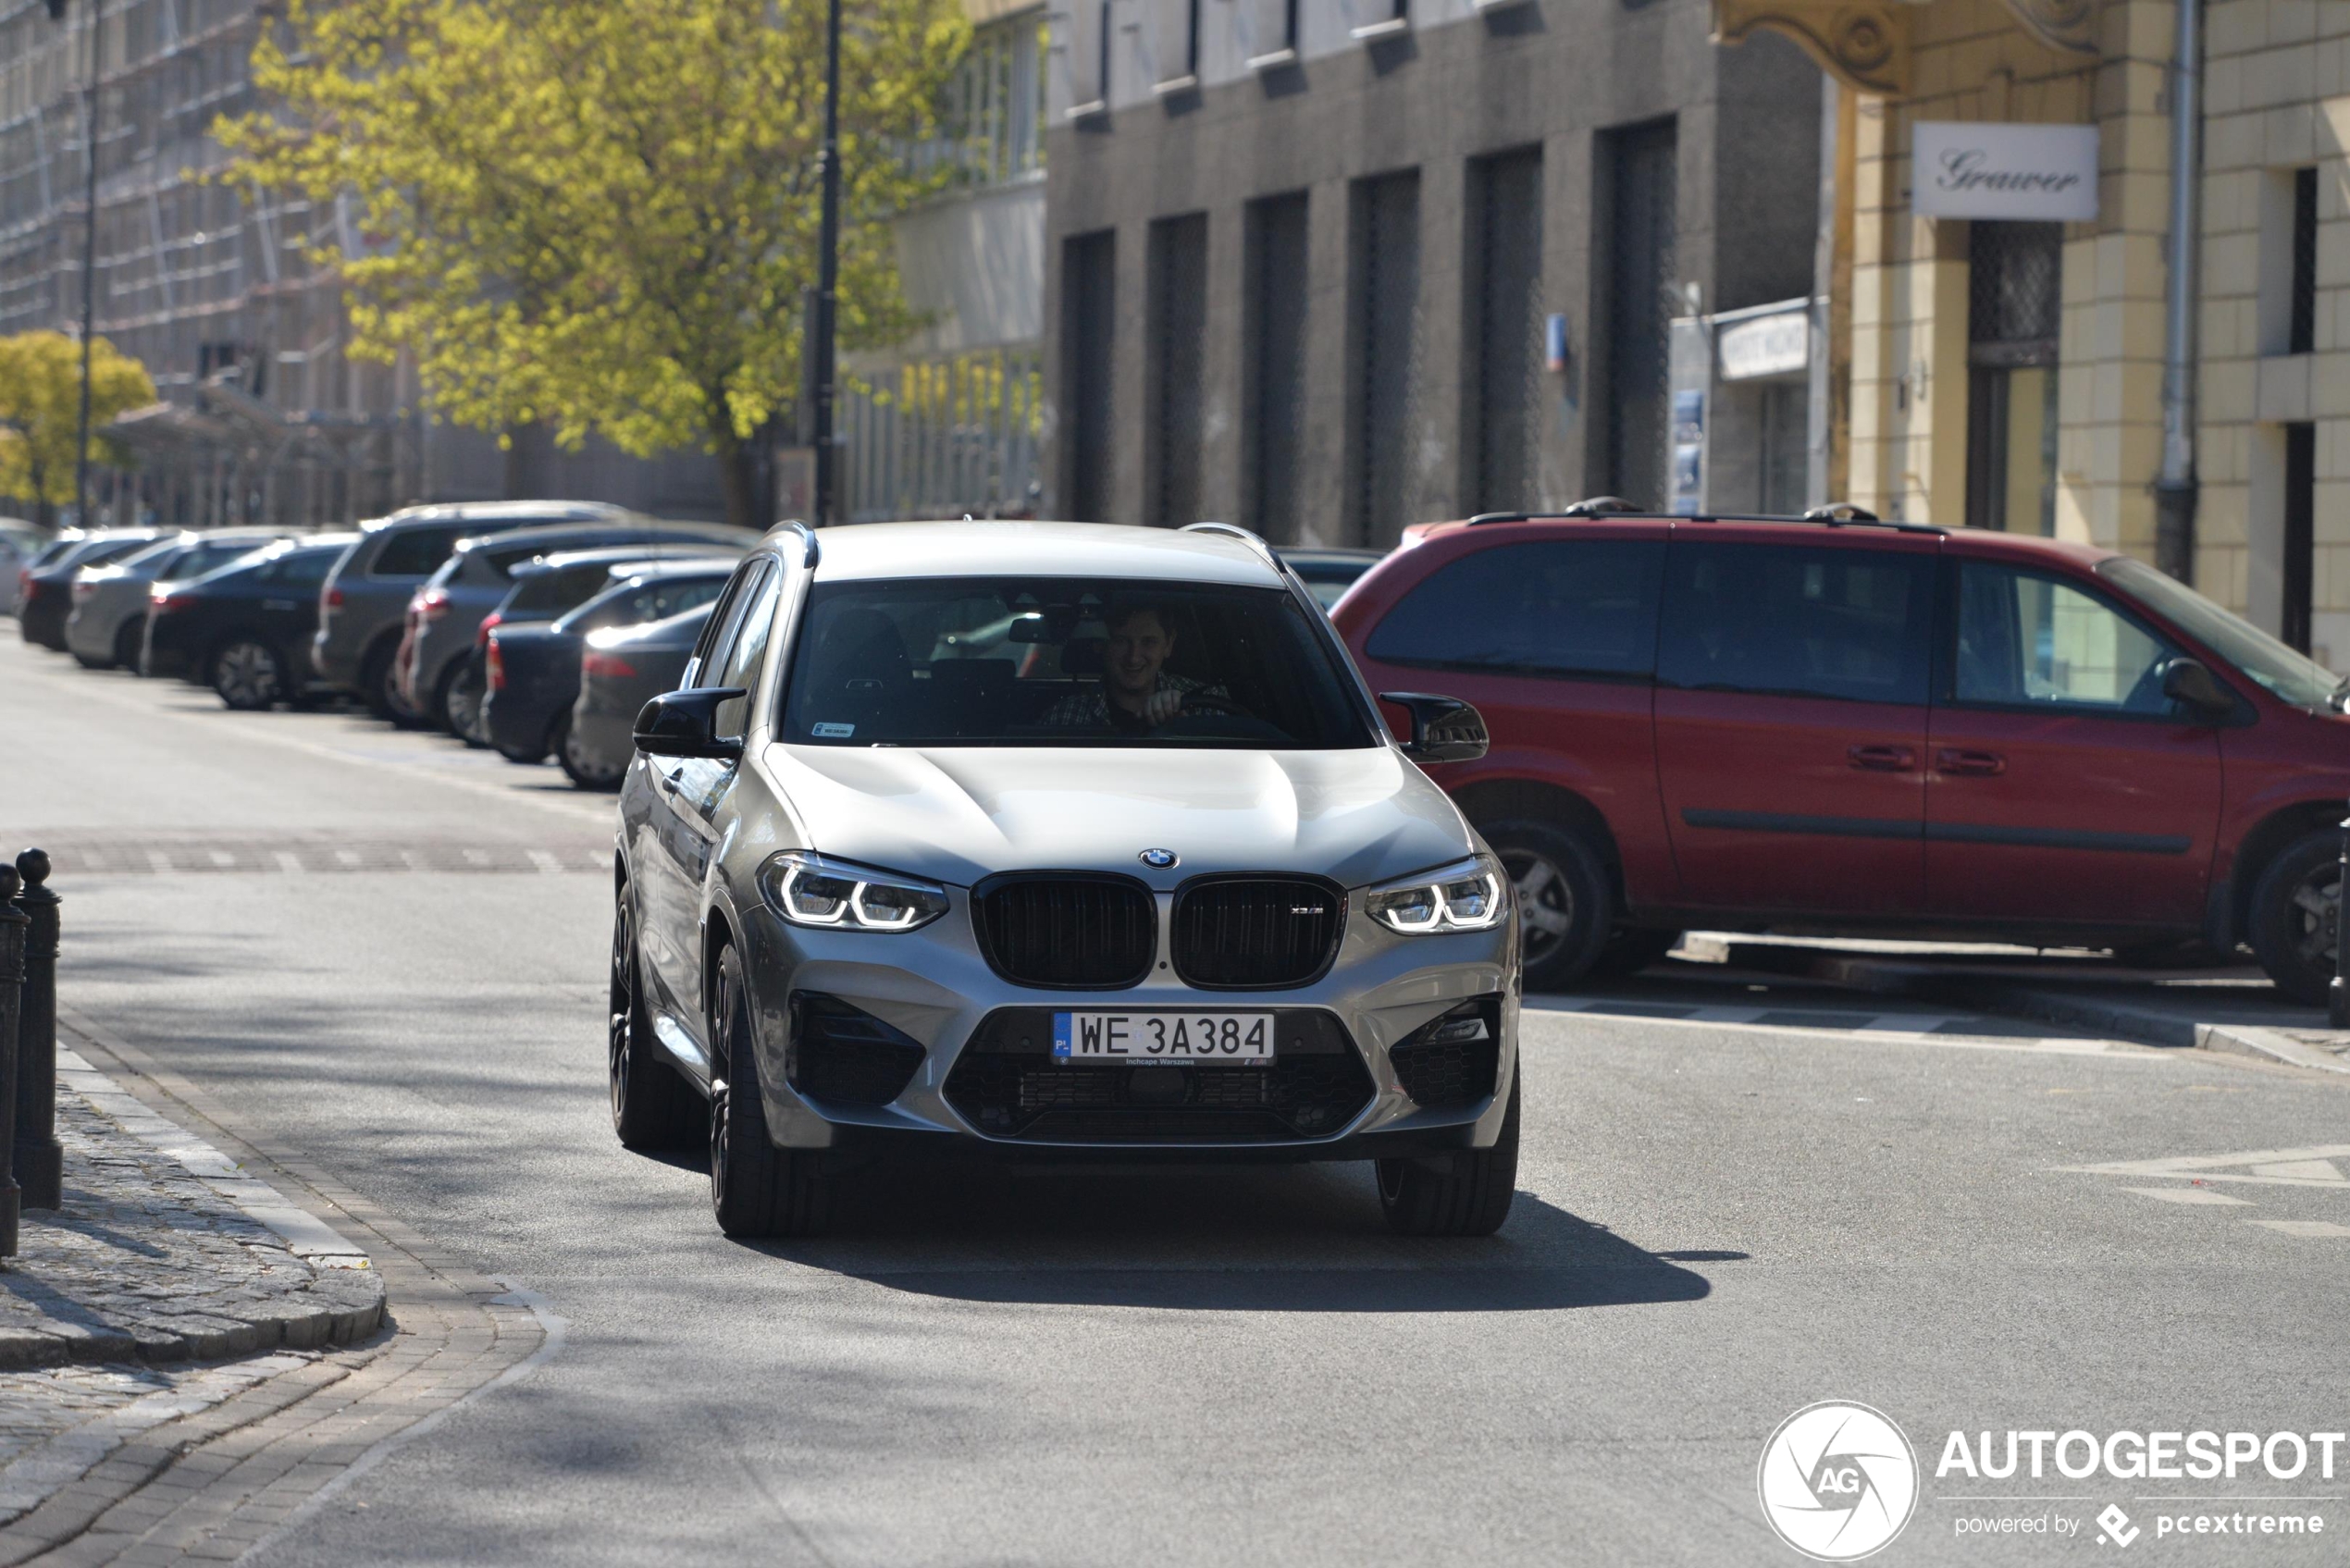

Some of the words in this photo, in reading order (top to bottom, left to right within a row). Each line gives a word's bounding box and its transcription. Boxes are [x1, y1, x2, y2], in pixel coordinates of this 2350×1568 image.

[1936, 148, 2080, 192] Grawer
[1056, 1040, 1069, 1050] PL
[1081, 1017, 1129, 1054] WE
[1145, 1018, 1265, 1055] 3A384
[1126, 1057, 1158, 1067] Inchcape
[1159, 1057, 1194, 1066] Warszawa
